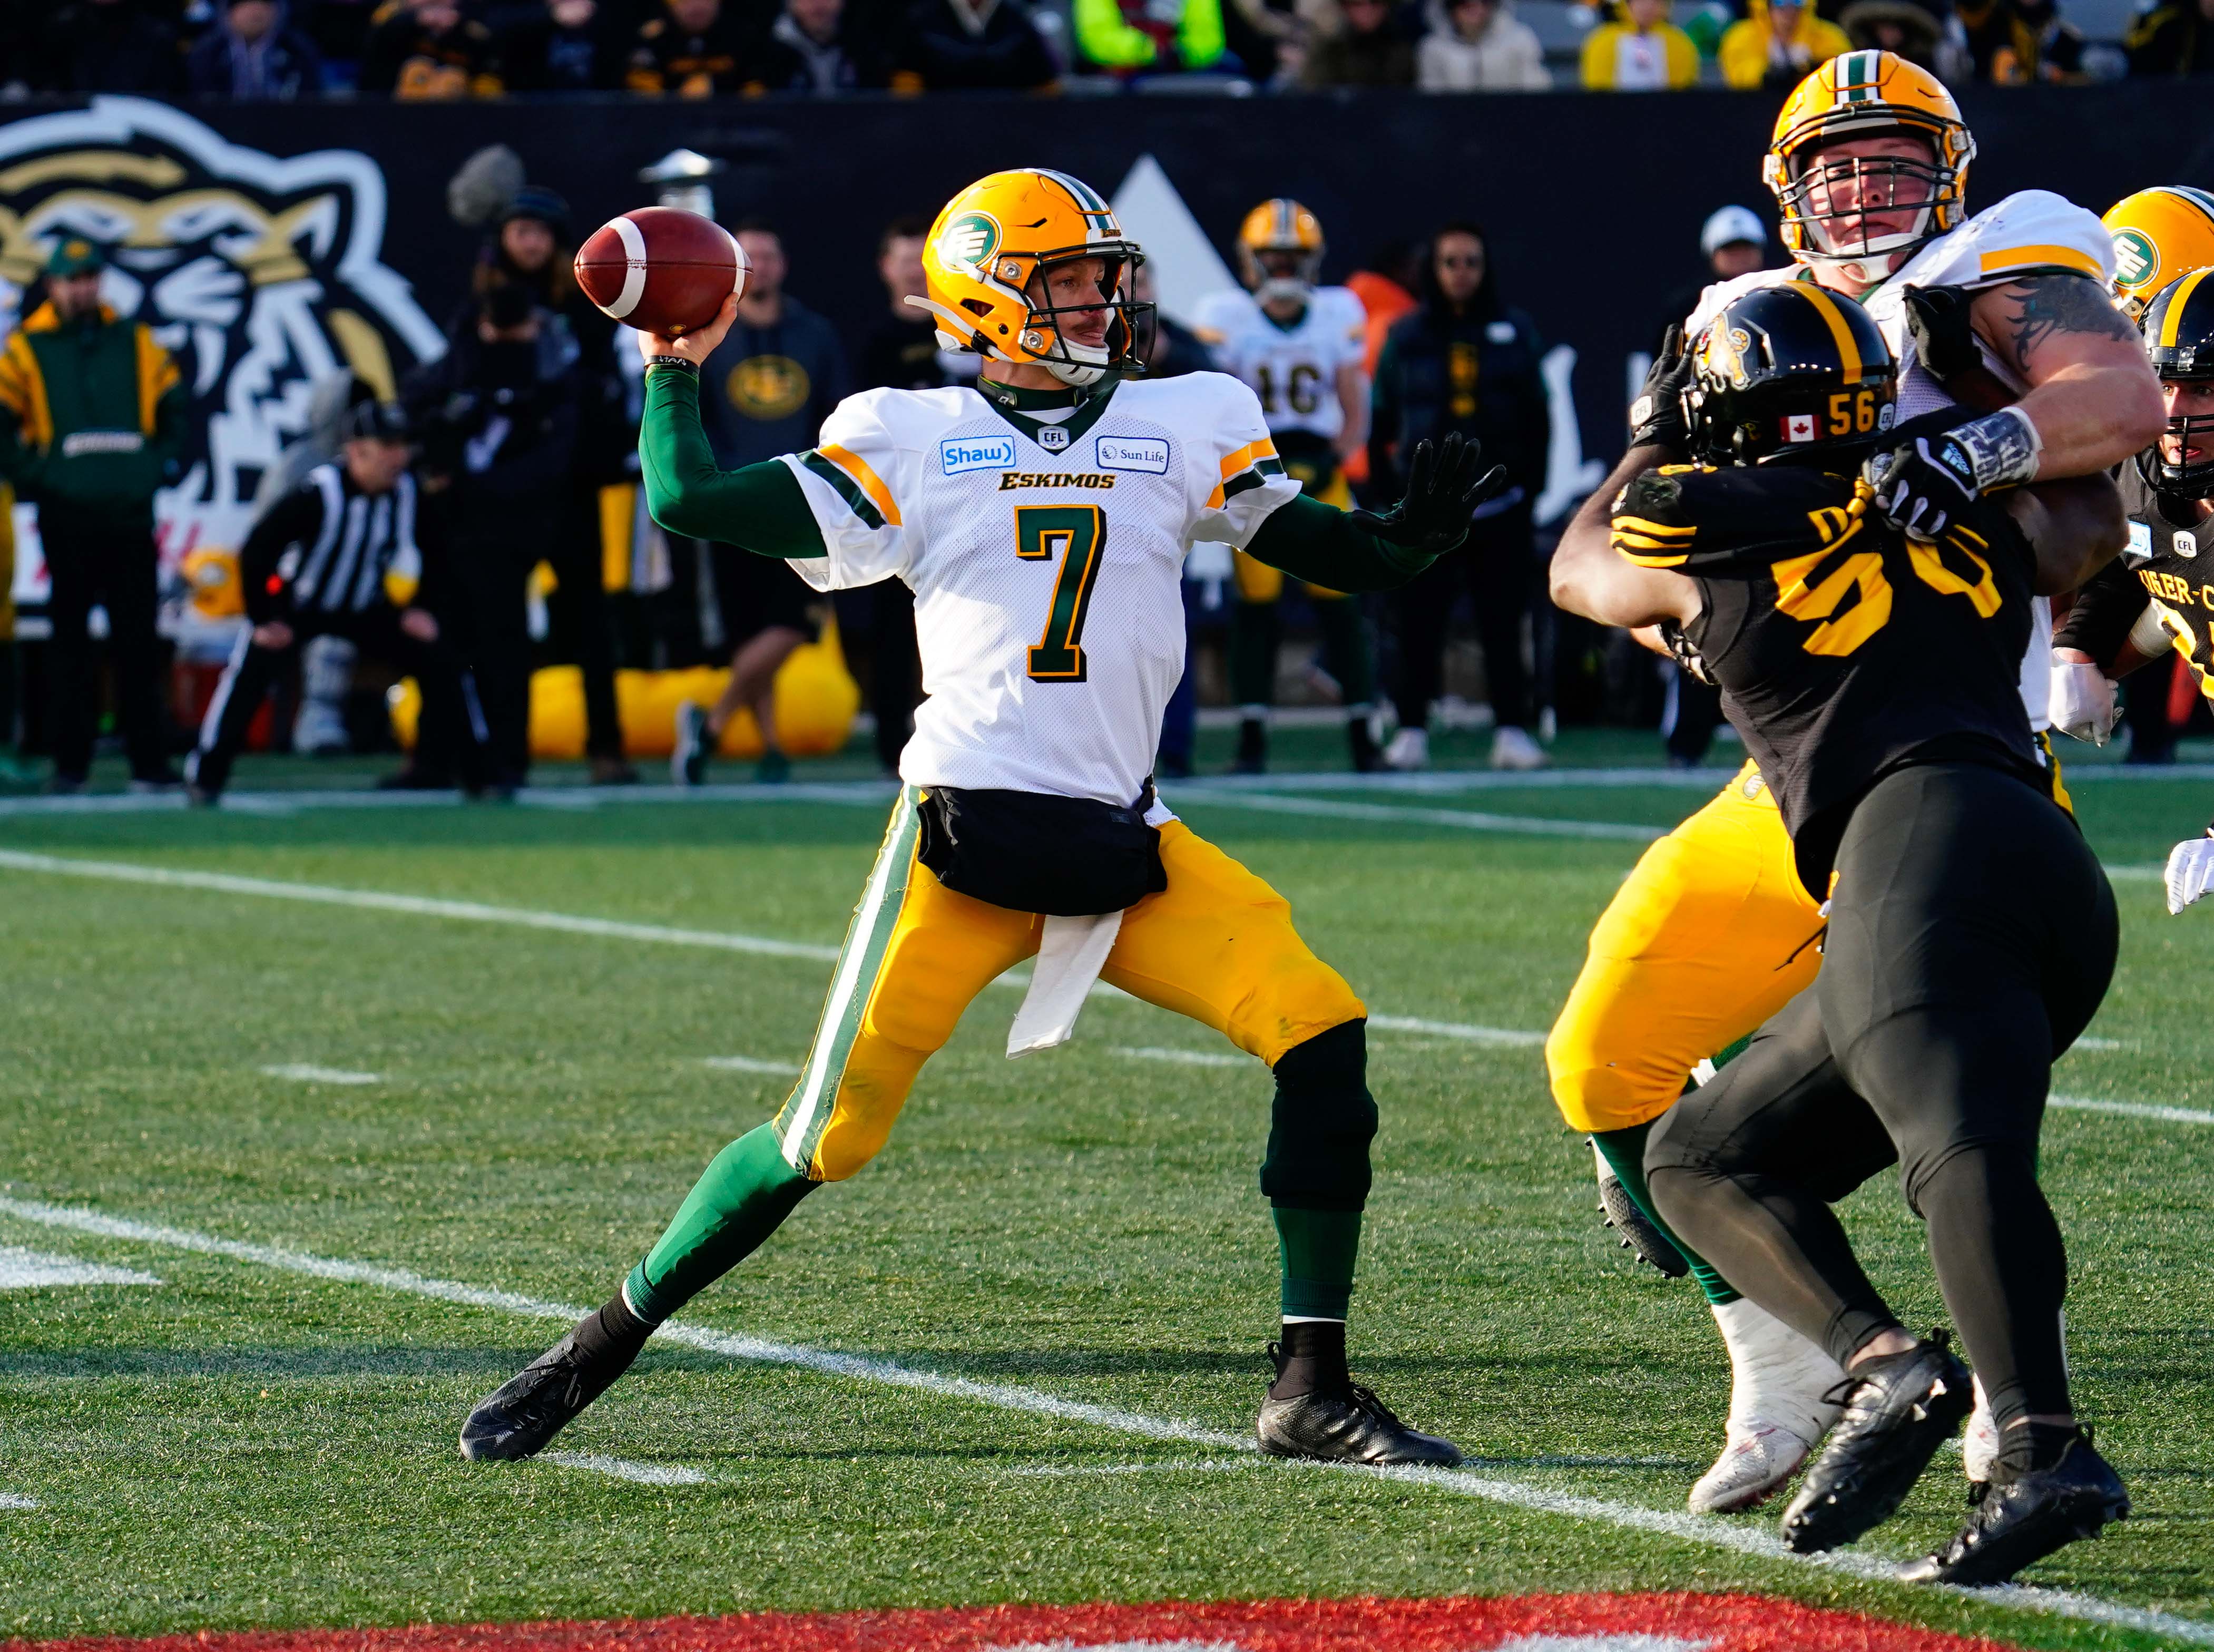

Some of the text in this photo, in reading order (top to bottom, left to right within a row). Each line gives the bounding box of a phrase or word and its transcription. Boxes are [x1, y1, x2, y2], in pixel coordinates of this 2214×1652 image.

[1829, 390, 1875, 435] 56
[1044, 432, 1064, 442] CFL
[1121, 449, 1164, 464] Sun Life
[998, 472, 1116, 491] ESKIMOS
[2178, 540, 2193, 551] CFL
[1014, 504, 1106, 683] 7
